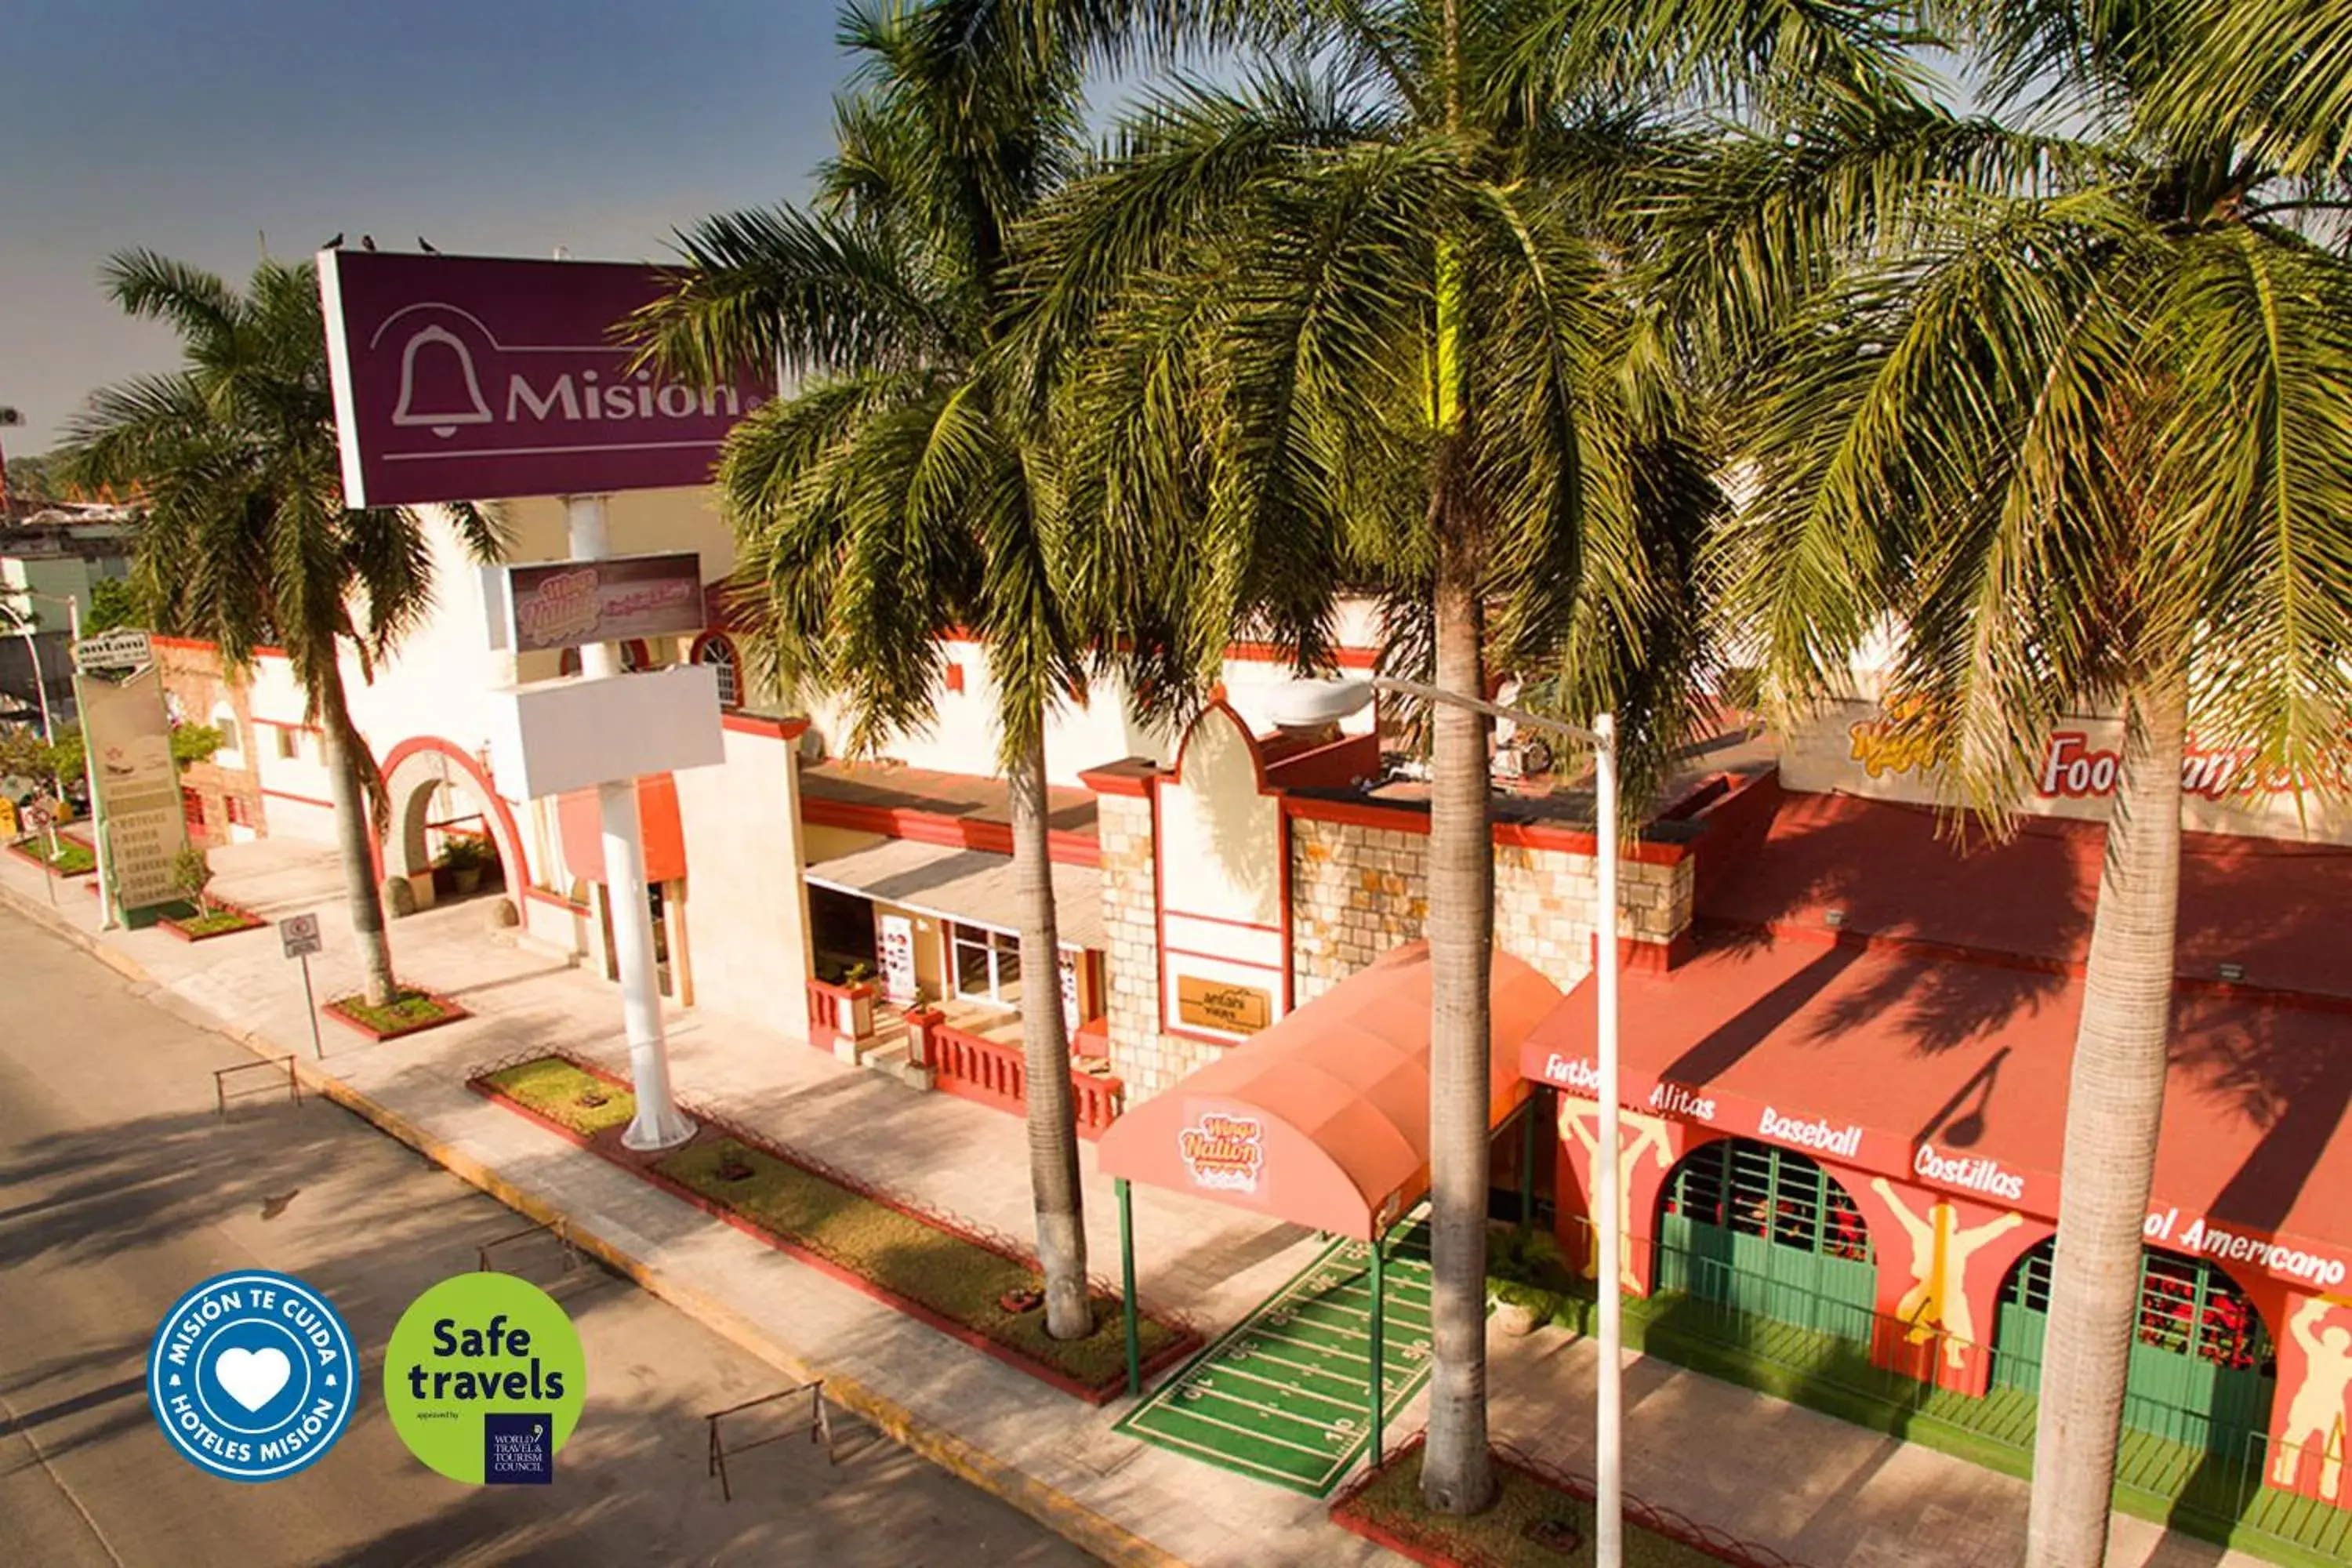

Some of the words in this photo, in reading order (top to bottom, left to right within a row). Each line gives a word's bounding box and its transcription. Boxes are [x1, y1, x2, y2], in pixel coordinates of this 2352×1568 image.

[506, 369, 739, 421] Misión
[2044, 737, 2115, 792] Foo
[1544, 1053, 1599, 1089] Futbo
[1649, 1082, 1717, 1121] Alitas
[1181, 1131, 1258, 1163] Nation
[1758, 1105, 1863, 1158] Baseball
[1913, 1143, 2025, 1200] Costillas
[2179, 1216, 2346, 1285] Americano
